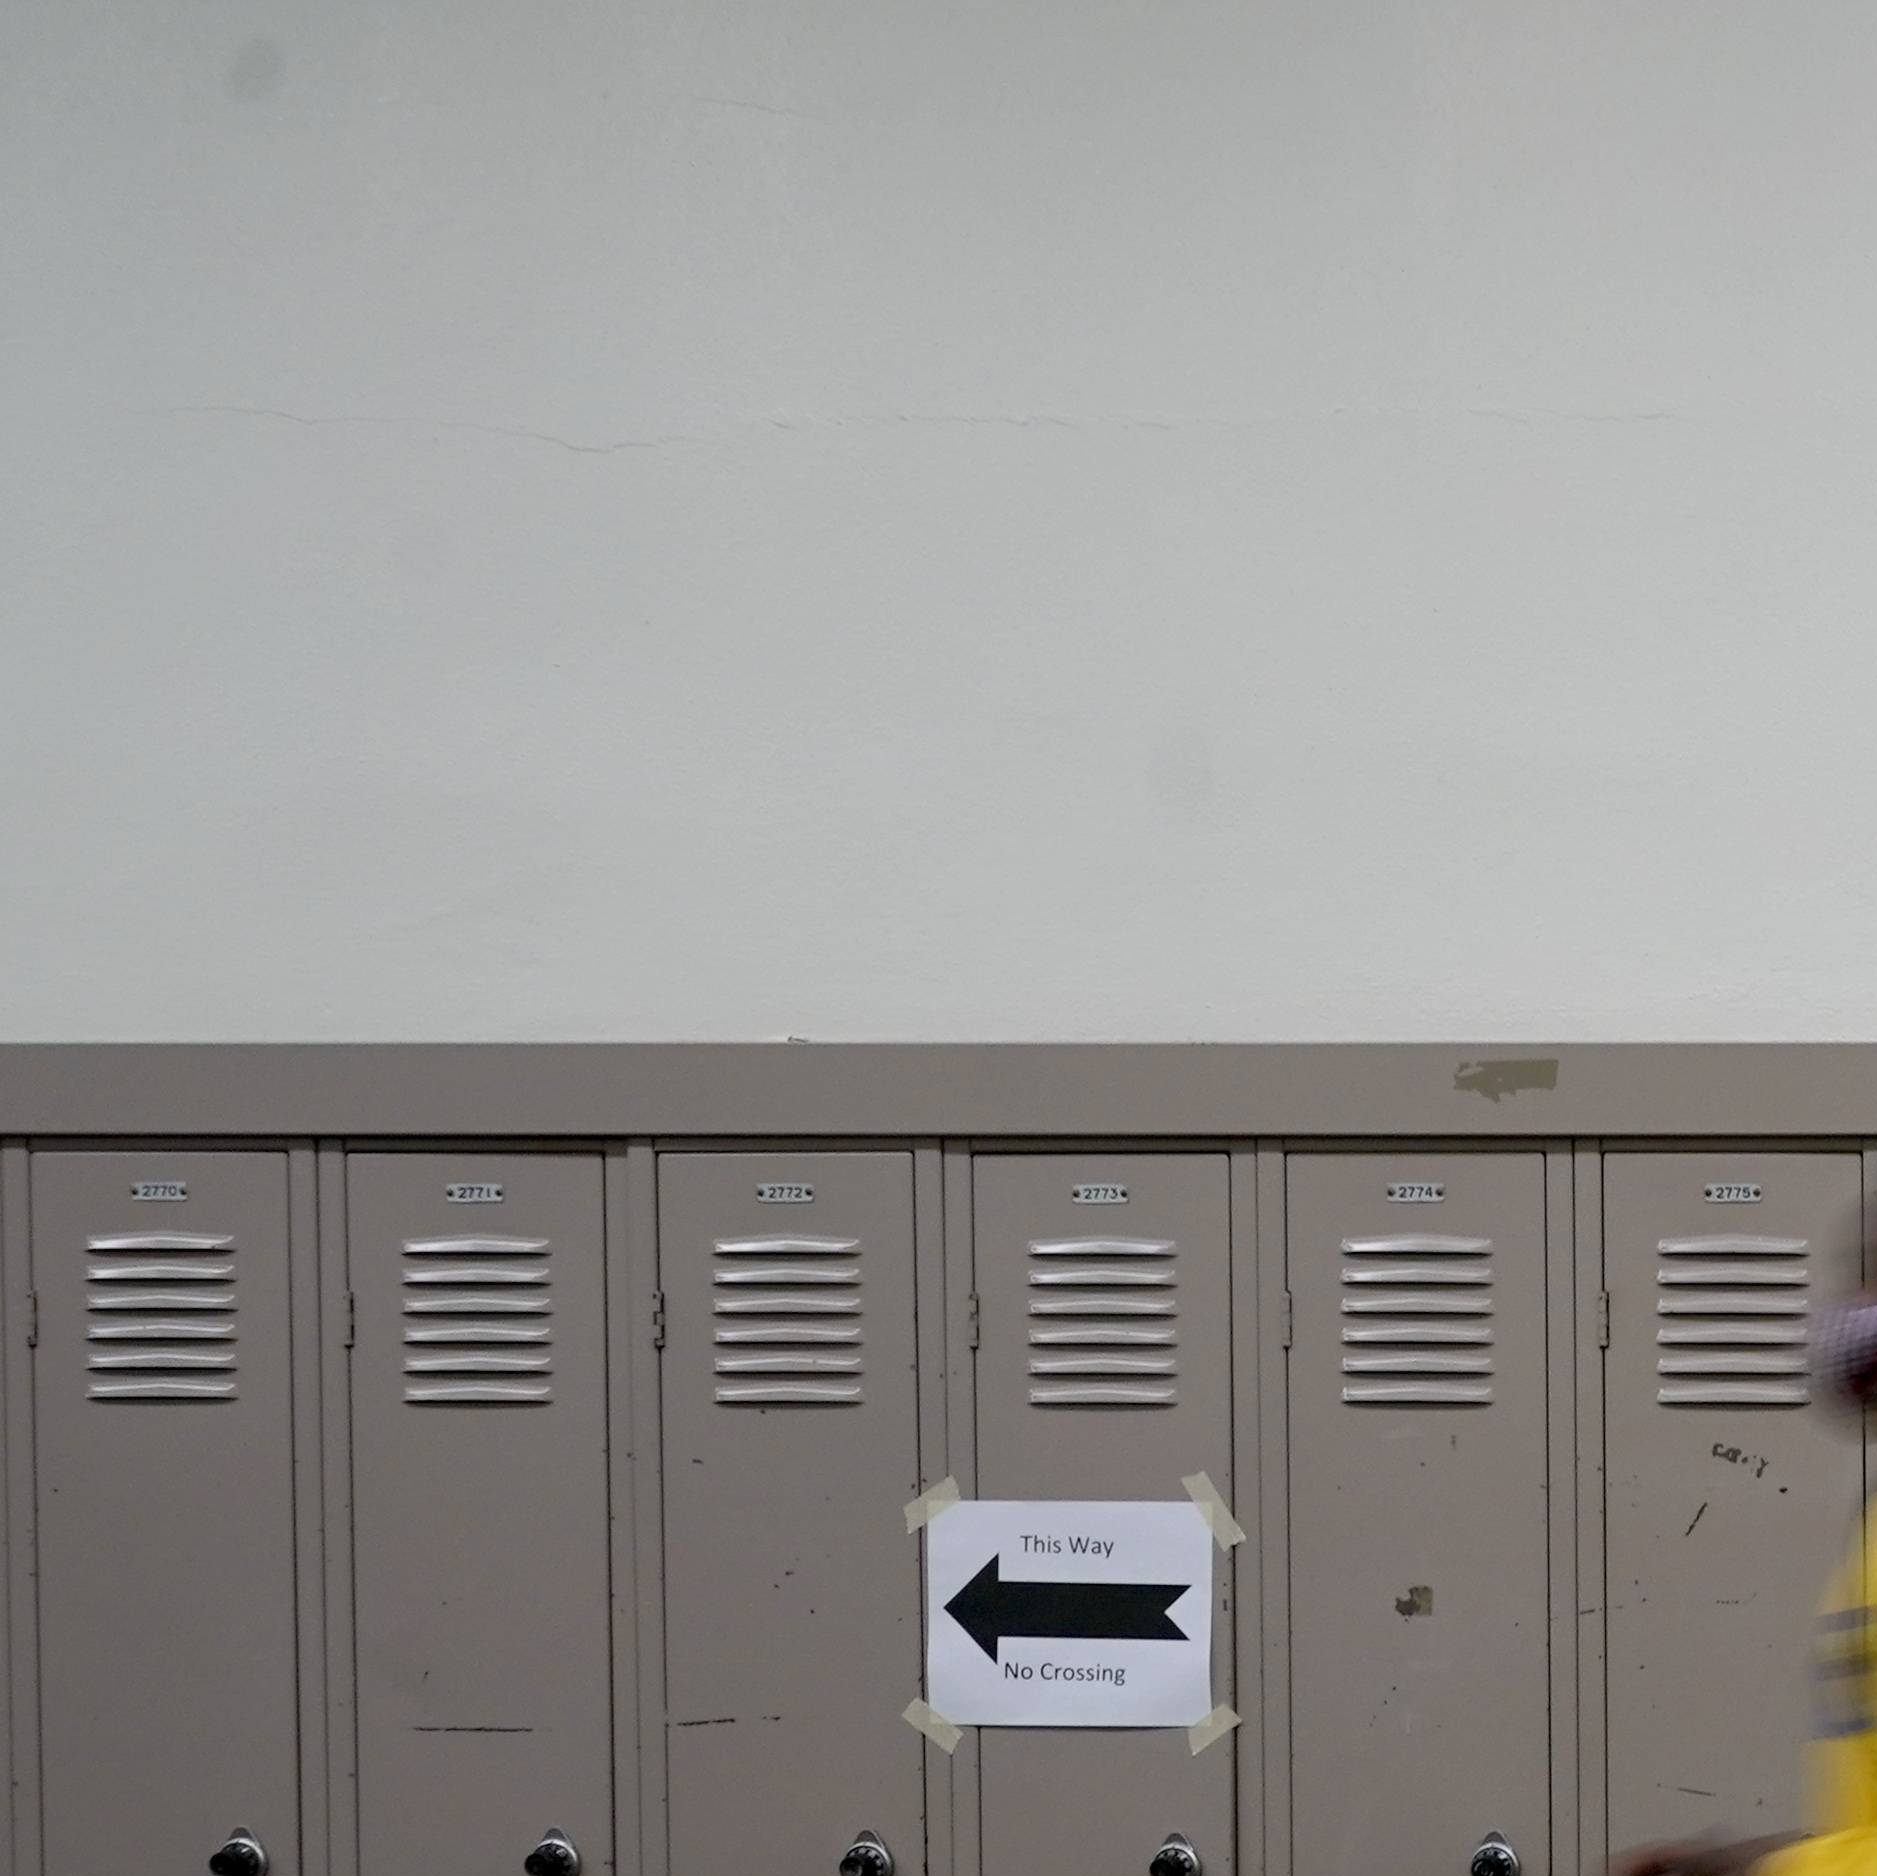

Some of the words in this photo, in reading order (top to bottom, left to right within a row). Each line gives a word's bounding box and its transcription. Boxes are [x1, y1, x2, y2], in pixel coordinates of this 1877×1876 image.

[141, 1186, 178, 1197] 2770
[457, 1187, 491, 1199] 2771
[768, 1187, 803, 1198] 2772
[1083, 1188, 1119, 1200] 2773
[1398, 1186, 1433, 1198] 2774
[1715, 1188, 1751, 1199] 2775
[1020, 1534, 1062, 1554] This
[1068, 1536, 1114, 1559] Way
[1004, 1662, 1033, 1680] No
[1040, 1662, 1126, 1686] Crossing
